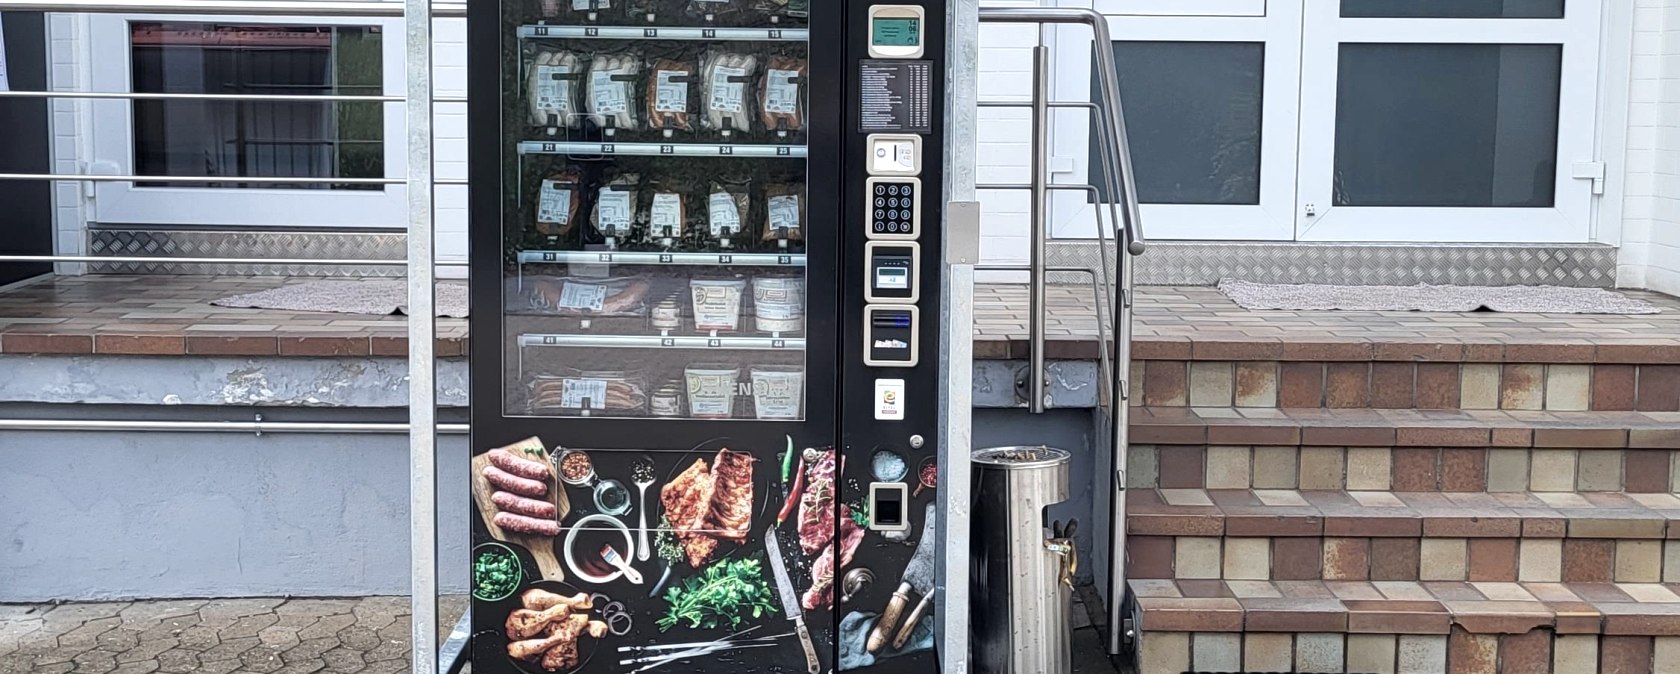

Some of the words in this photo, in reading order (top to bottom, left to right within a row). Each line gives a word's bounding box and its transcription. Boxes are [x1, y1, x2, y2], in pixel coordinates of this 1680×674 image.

[587, 28, 596, 36] 12
[779, 147, 788, 155] 25
[780, 256, 789, 264] 35
[545, 336, 554, 344] 41
[663, 338, 672, 346] 42
